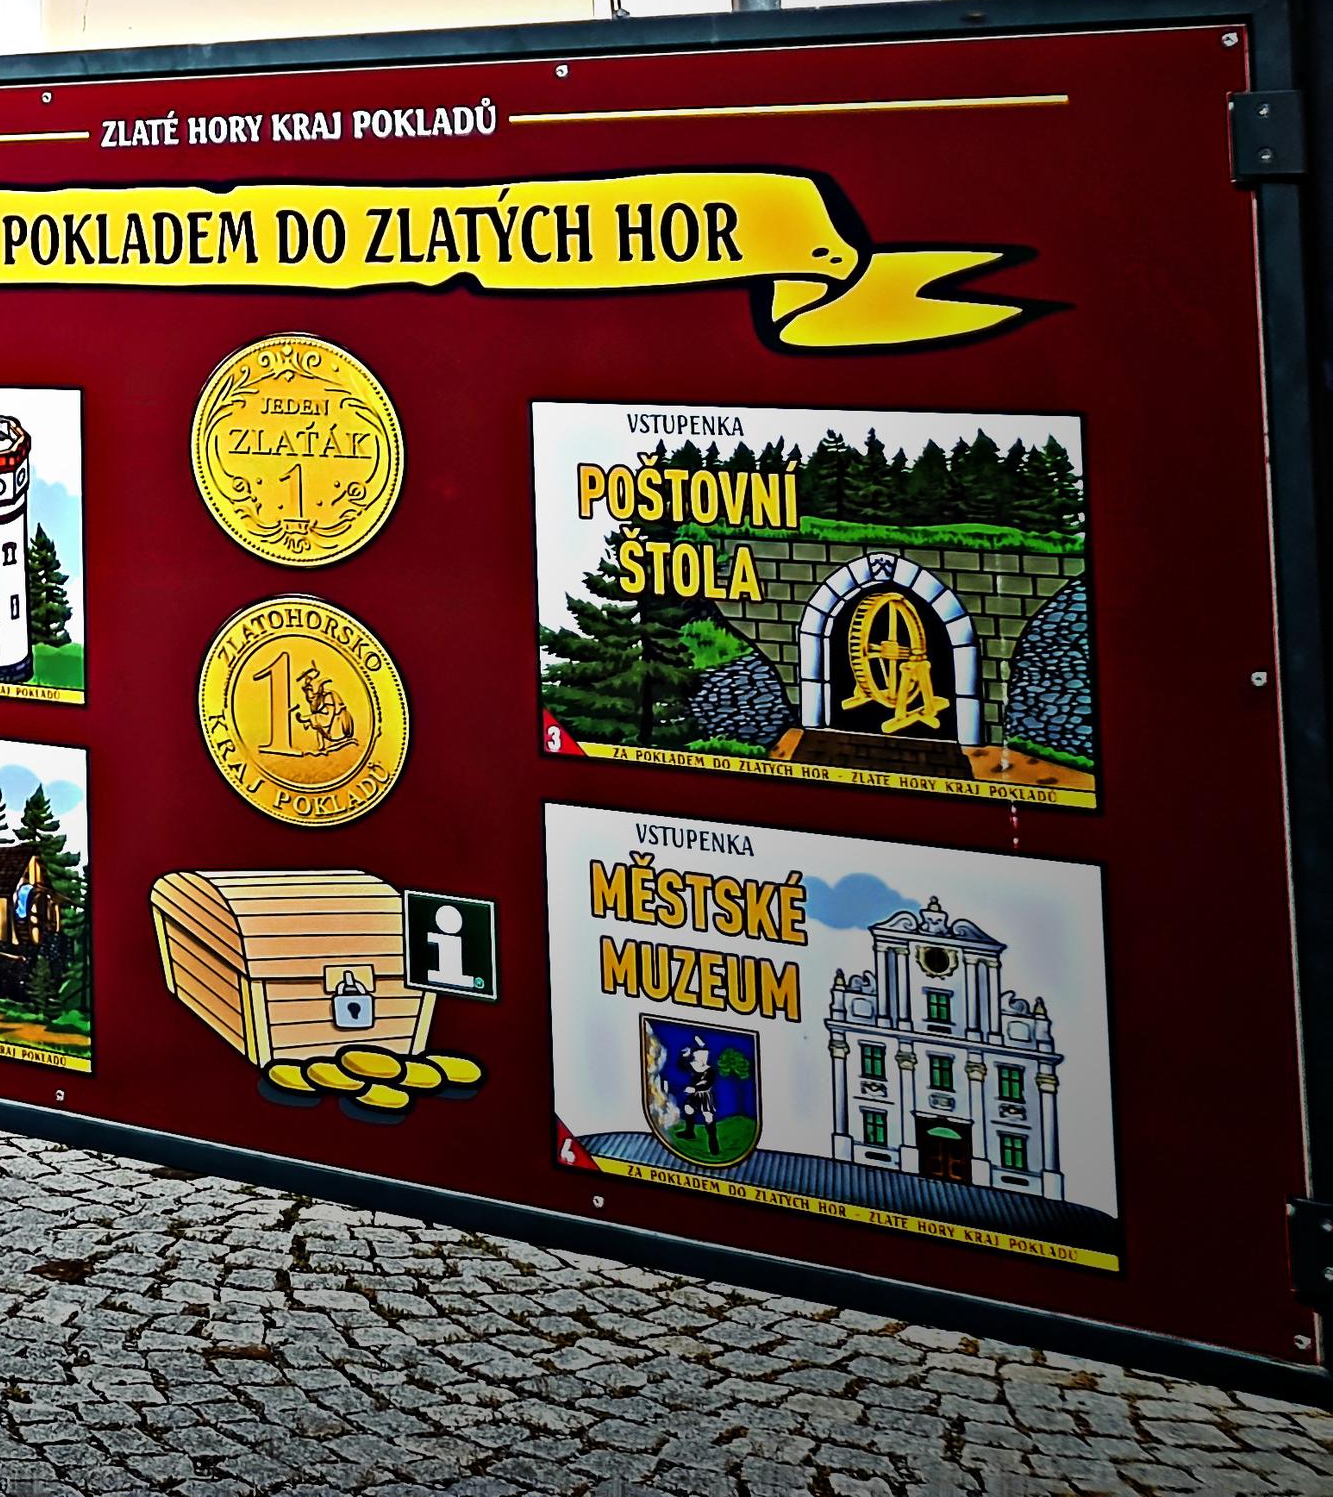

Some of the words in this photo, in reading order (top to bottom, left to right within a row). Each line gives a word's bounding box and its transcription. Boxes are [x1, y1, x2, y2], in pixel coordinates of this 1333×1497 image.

[100, 110, 180, 149] ZLATÉ
[188, 113, 264, 145] HORY
[271, 111, 343, 142] KRAJ
[353, 97, 497, 140] POKLADŮ
[1, 209, 259, 267] POKLADEM
[275, 208, 346, 265] DO
[364, 187, 594, 264] ZLATÝCH
[614, 201, 744, 264] HOR
[260, 397, 330, 416] JEDEN
[627, 413, 745, 437] VSTUPENKA
[228, 421, 373, 459] ZLAŤÁK
[278, 463, 311, 523] 1
[577, 452, 801, 530] POŠTOVNÍ
[617, 523, 765, 604] ŠTOLA
[217, 608, 383, 672] ZLATOHORSKO
[253, 651, 304, 758] 1
[208, 708, 266, 794] KRAJ
[546, 725, 562, 753] 3
[272, 760, 393, 817] POKLADŮ
[613, 747, 628, 761] ZA
[635, 749, 705, 768] POKLADEM
[713, 757, 731, 771] DO
[802, 766, 830, 780] HOR
[899, 777, 937, 791] HORY
[945, 782, 980, 796] KRAJ
[635, 822, 755, 857] VSTUPENKA
[589, 850, 809, 946] MĚSTSKÉ
[600, 934, 802, 1024] MUZEUM
[560, 1138, 576, 1165] 6
[627, 1164, 643, 1179] ZA
[650, 1169, 721, 1193] POKLADEM
[728, 1184, 747, 1199] DO
[818, 1202, 847, 1219] HOR
[917, 1220, 955, 1239] HORY
[964, 1229, 1000, 1248] KRAJ
